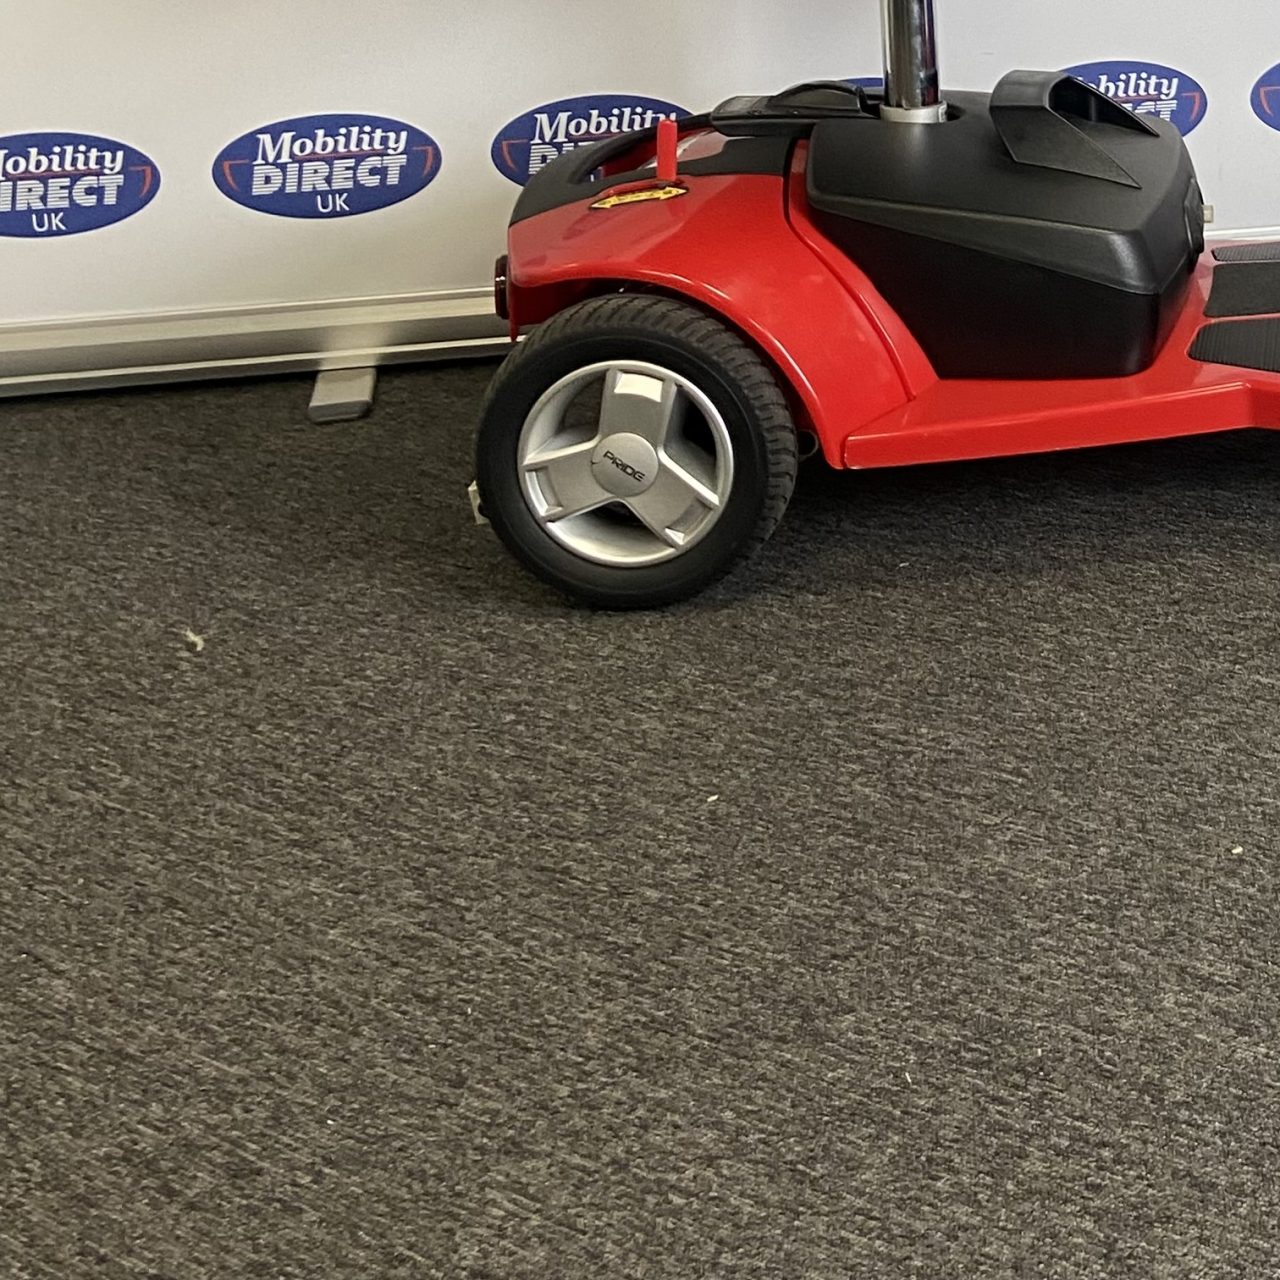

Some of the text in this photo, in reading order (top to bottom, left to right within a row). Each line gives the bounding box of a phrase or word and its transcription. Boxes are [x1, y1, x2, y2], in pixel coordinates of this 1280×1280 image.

[1079, 72, 1178, 99] bility
[530, 106, 677, 143] Mobilit
[0, 145, 124, 180] obility
[256, 126, 407, 164] Mobility
[252, 154, 407, 195] DIRECT
[0, 175, 124, 211] IRECT
[316, 194, 350, 213] UK
[32, 212, 66, 231] UK
[603, 450, 646, 482] PRIDE
